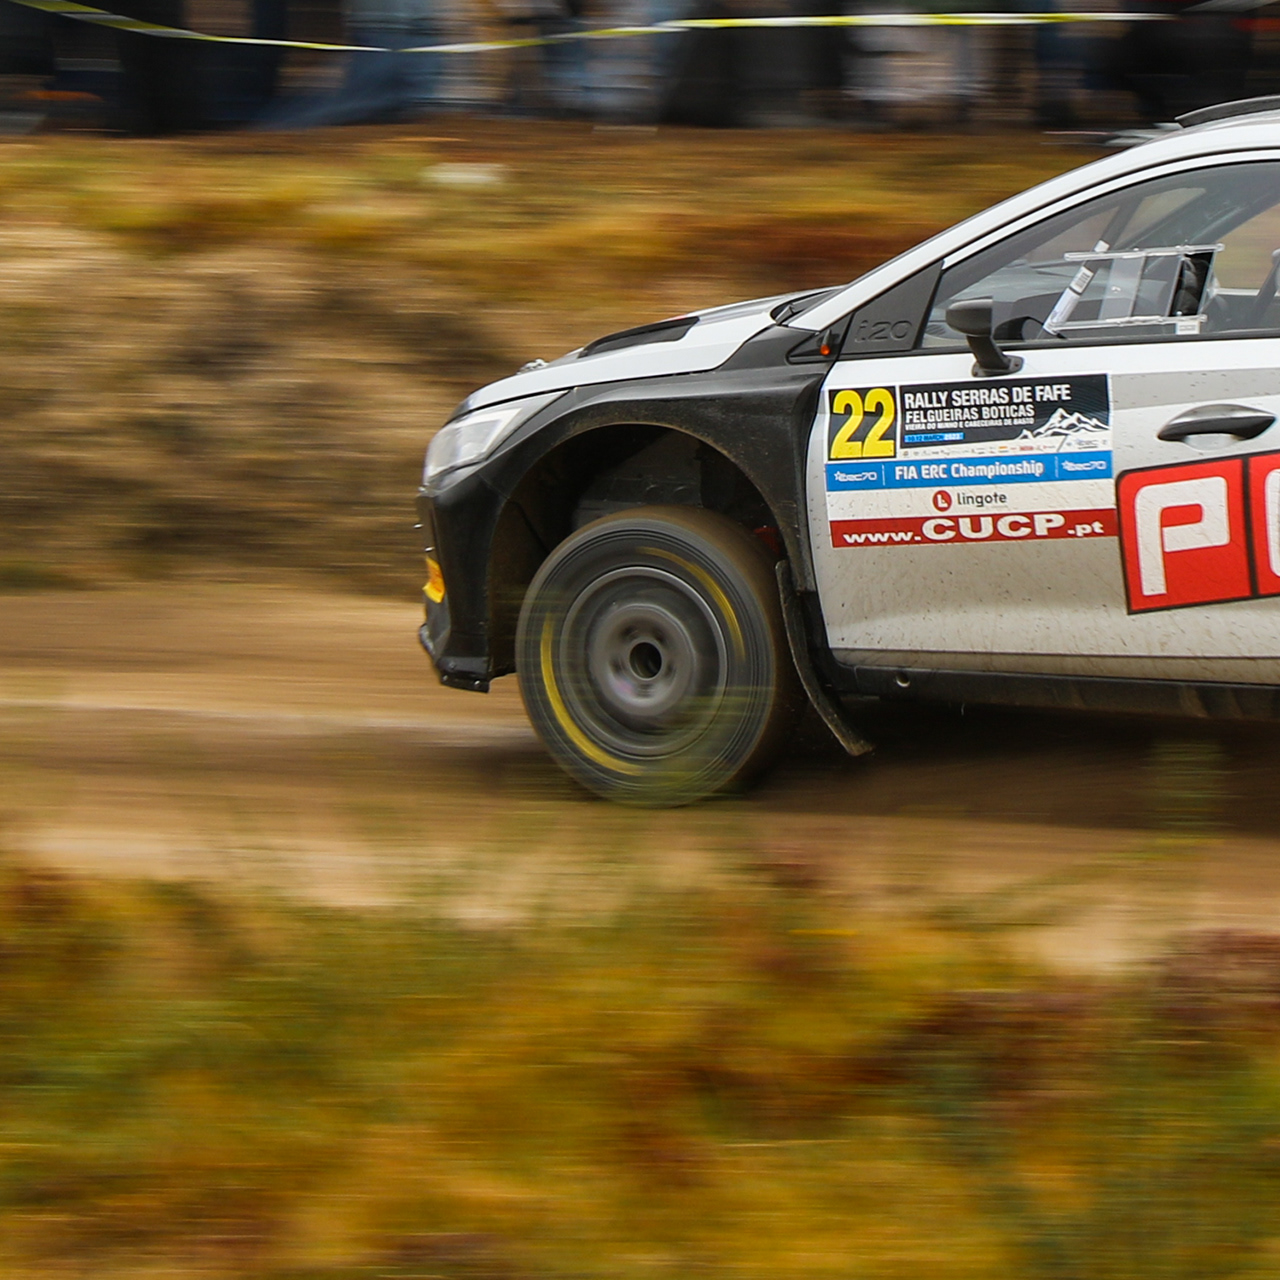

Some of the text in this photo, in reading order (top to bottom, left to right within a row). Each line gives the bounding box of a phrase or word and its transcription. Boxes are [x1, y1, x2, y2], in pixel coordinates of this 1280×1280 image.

[904, 384, 1072, 409] RALLY SERRAS DE FAFE
[830, 388, 896, 459] 22
[905, 404, 1035, 423] FELGUEIRAS BOTICAS
[895, 460, 1044, 480] FIA ERC Championship
[957, 492, 1007, 507] lingote
[842, 513, 1105, 544] www.CUCP.pt
